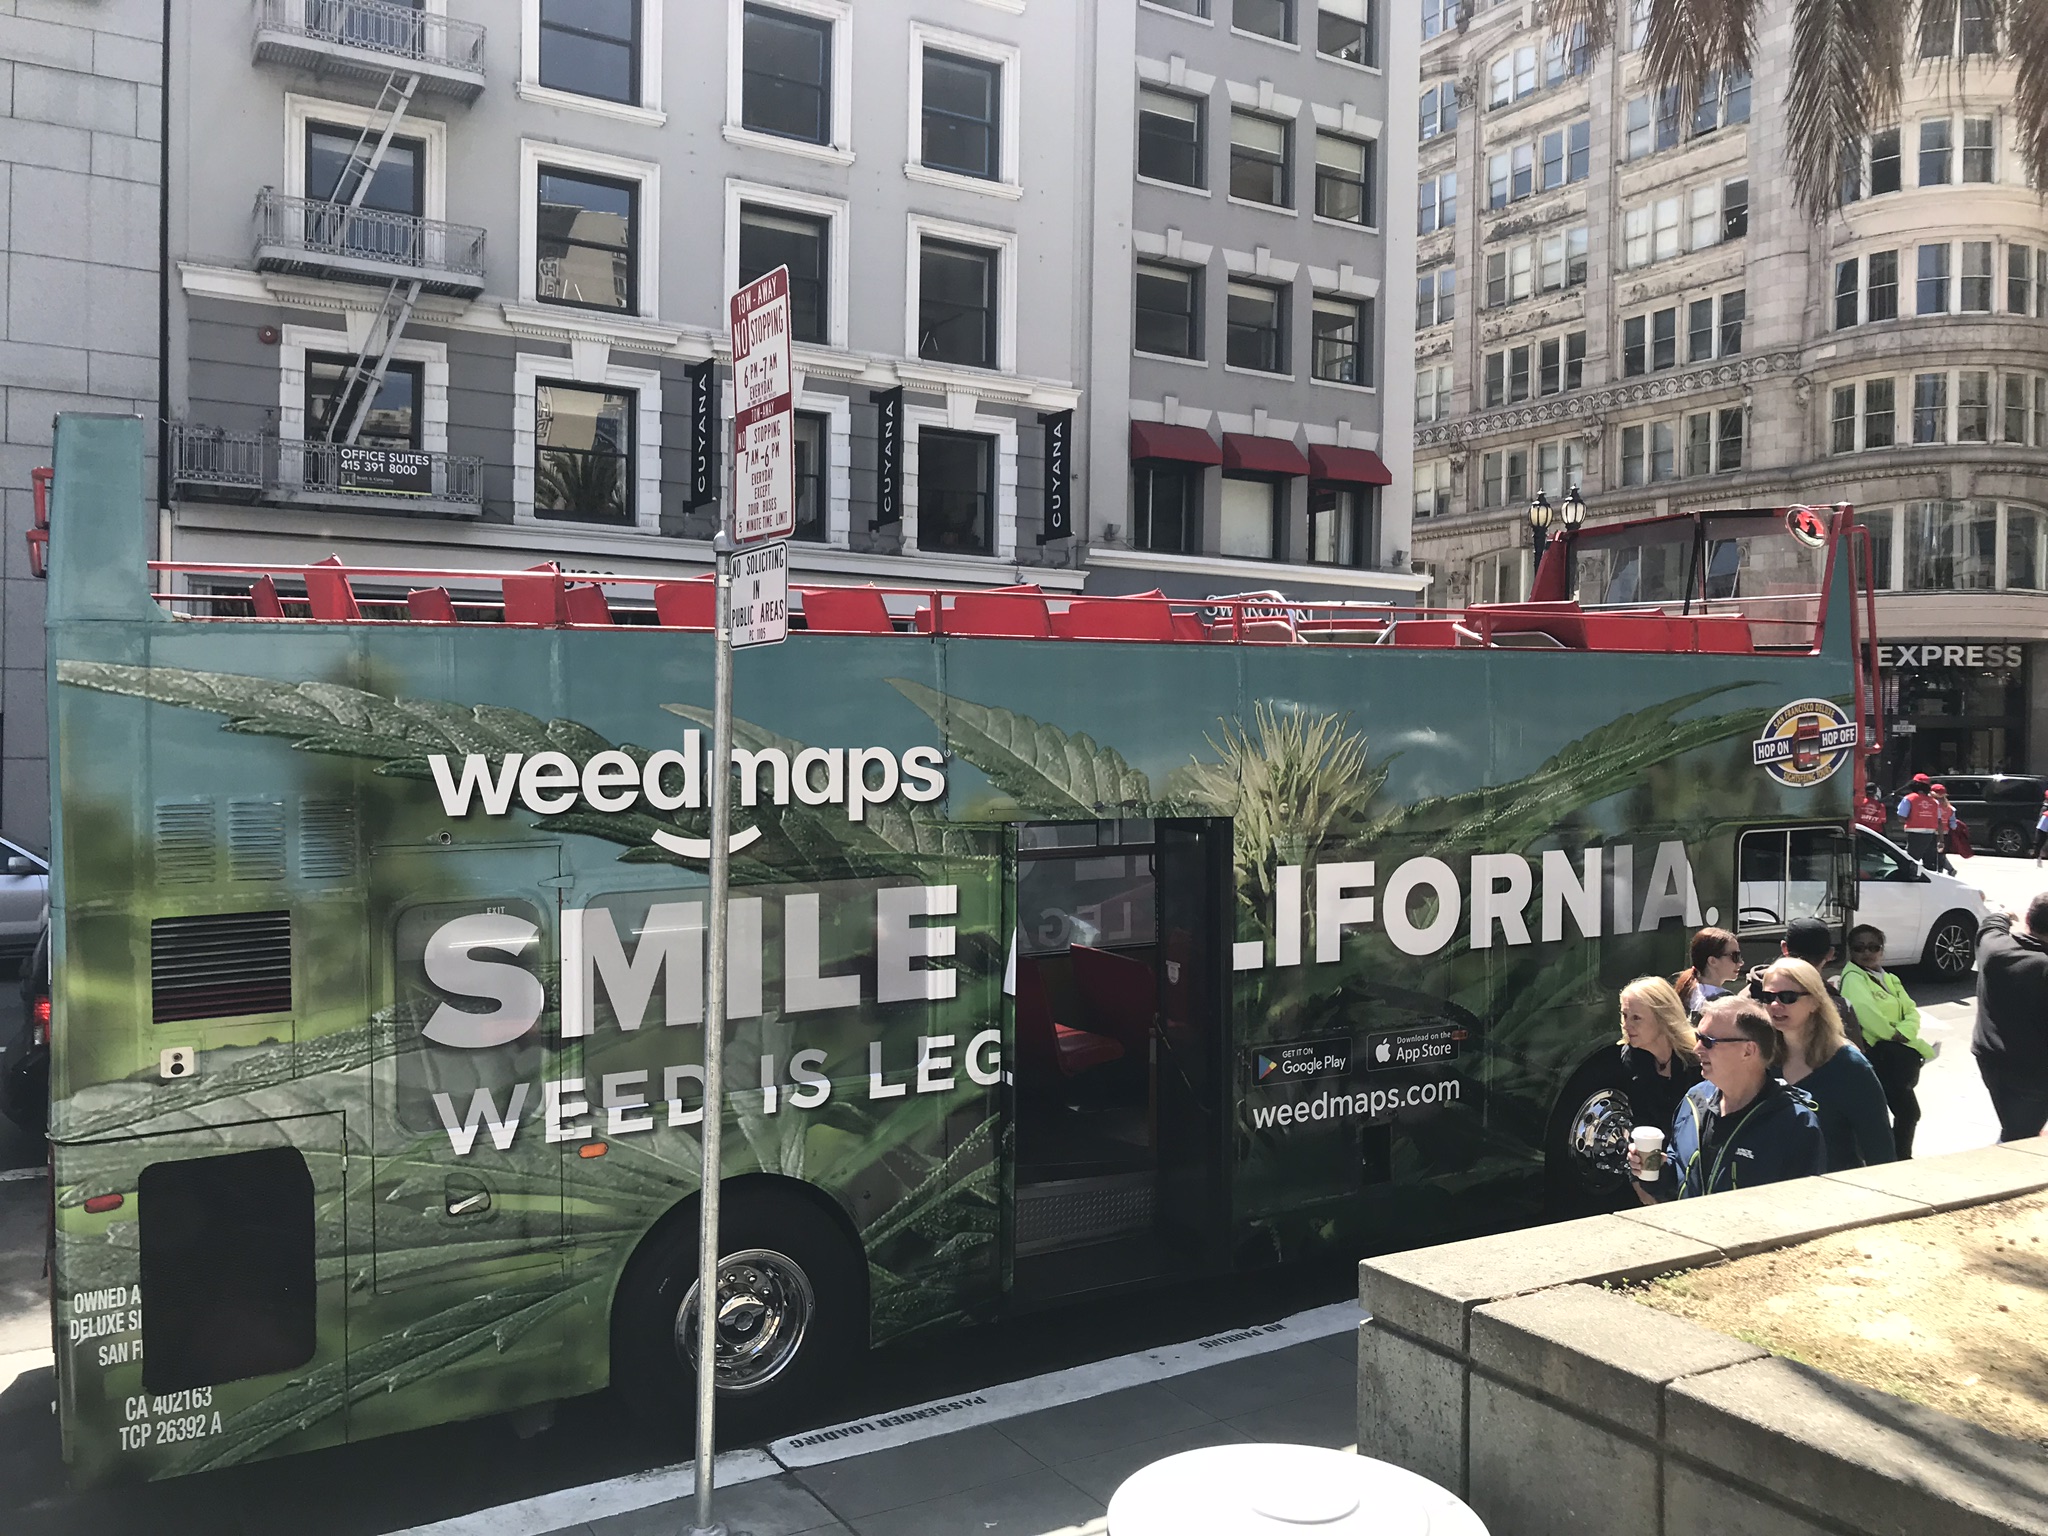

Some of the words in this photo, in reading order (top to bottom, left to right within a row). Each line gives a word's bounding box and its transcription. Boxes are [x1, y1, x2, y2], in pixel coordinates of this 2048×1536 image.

[734, 318, 748, 358] NO
[750, 304, 784, 347] STOPPING
[744, 366, 749, 388] 6
[750, 362, 758, 380] PM
[769, 352, 777, 371] AM
[750, 377, 773, 400] EVERYDAY
[698, 374, 706, 492] CUYANA
[738, 431, 745, 450] NO
[754, 420, 780, 444] STOPPING
[341, 449, 385, 462] OFFICE
[389, 453, 429, 466] SUITES
[341, 460, 360, 470] 415
[364, 462, 384, 472] 391
[389, 465, 417, 475] 8000
[745, 451, 749, 473] 7
[751, 448, 759, 466] AM
[772, 441, 779, 459] PM
[884, 400, 894, 512] CUYANA
[752, 467, 773, 485] EVERYDAY
[1052, 422, 1063, 527] CUYANA
[755, 484, 770, 499] EXCEPT
[748, 502, 759, 516] TOUR
[763, 497, 776, 512] BUSES
[739, 522, 742, 533] 5
[746, 517, 761, 532] MINUTE
[763, 515, 772, 528] TIME
[776, 511, 787, 526] LIMIT
[732, 559, 741, 579] NO
[747, 547, 783, 575] SOLICITING
[753, 580, 760, 599] IN
[732, 605, 754, 628] PUBLIC
[760, 599, 783, 623] AREAS
[749, 630, 754, 640] PC
[1876, 645, 2022, 667] EXPRESS
[1773, 716, 1785, 730] SAN
[1784, 703, 1814, 719] FRANCISCO
[1815, 703, 1835, 718] DELUXE
[1822, 731, 1838, 746] HOP
[1840, 729, 1855, 742] OFF
[1758, 744, 1776, 759] HOP
[1777, 741, 1789, 754] ON
[428, 728, 946, 821] weedmaps
[486, 906, 505, 915] EXIT
[422, 884, 958, 1048] SMILE
[1397, 1033, 1428, 1044] Download
[1440, 1031, 1451, 1039] the
[1282, 1050, 1296, 1058] GET
[1396, 1047, 1420, 1062] App
[1422, 1043, 1451, 1058] Store
[1282, 1057, 1322, 1075] Google
[1324, 1055, 1346, 1070] Play
[432, 1064, 704, 1155] WEED
[760, 1049, 831, 1114] IS
[1253, 1079, 1460, 1129] weedmaps.com
[74, 1286, 126, 1314] OWNED
[70, 1312, 124, 1340] DELUXE
[1263, 1323, 1287, 1332] NO
[1198, 1330, 1264, 1348] PARKING
[98, 1342, 128, 1366] SAN
[126, 1396, 148, 1421] CA
[152, 1386, 212, 1416] 402163
[876, 1396, 987, 1428] PASSENGER
[119, 1423, 151, 1450] TCP
[156, 1414, 206, 1444] 26392
[210, 1411, 222, 1434] A
[789, 1423, 876, 1448] LOADING
